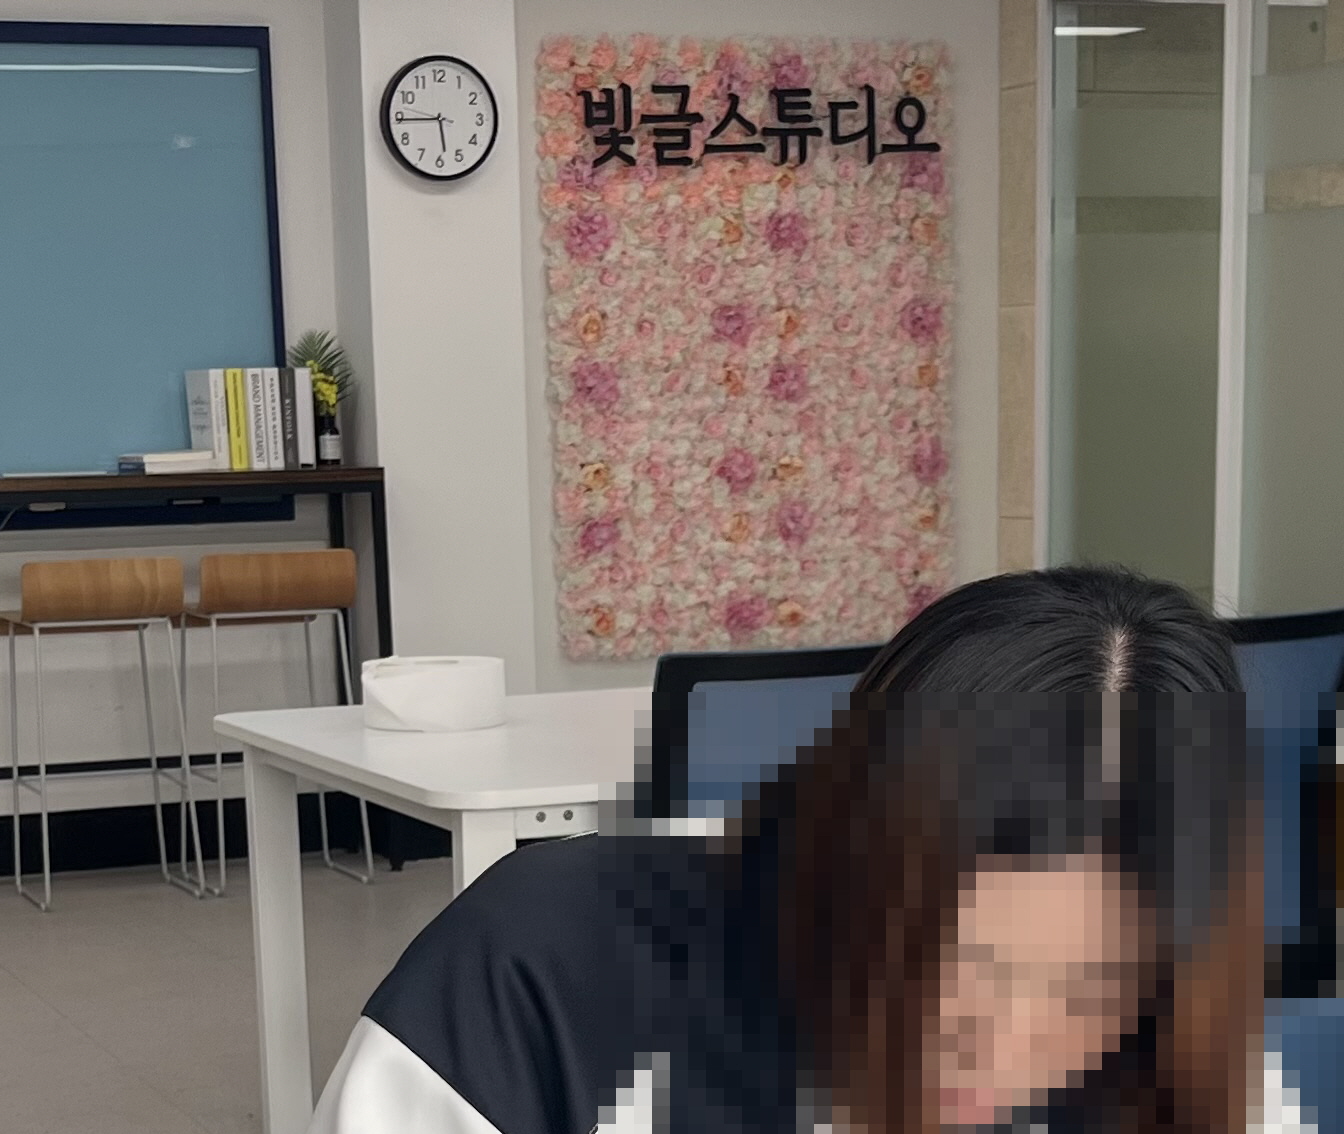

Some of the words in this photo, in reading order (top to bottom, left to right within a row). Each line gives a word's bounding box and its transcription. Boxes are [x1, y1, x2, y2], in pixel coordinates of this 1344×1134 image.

[414, 75, 426, 89] 11
[432, 69, 446, 83] 12
[456, 75, 462, 89] 1
[400, 90, 415, 105] 10
[468, 91, 478, 105] 2
[395, 111, 404, 124] 9
[475, 112, 484, 126] 3
[576, 82, 942, 168] 빛글스튜디오
[400, 132, 410, 146] 8
[468, 133, 478, 146] 4
[417, 148, 426, 161] 7
[435, 154, 445, 168] 6
[454, 149, 464, 162] 5
[250, 373, 262, 403] BRAND
[253, 404, 266, 464] MANAGEMENT
